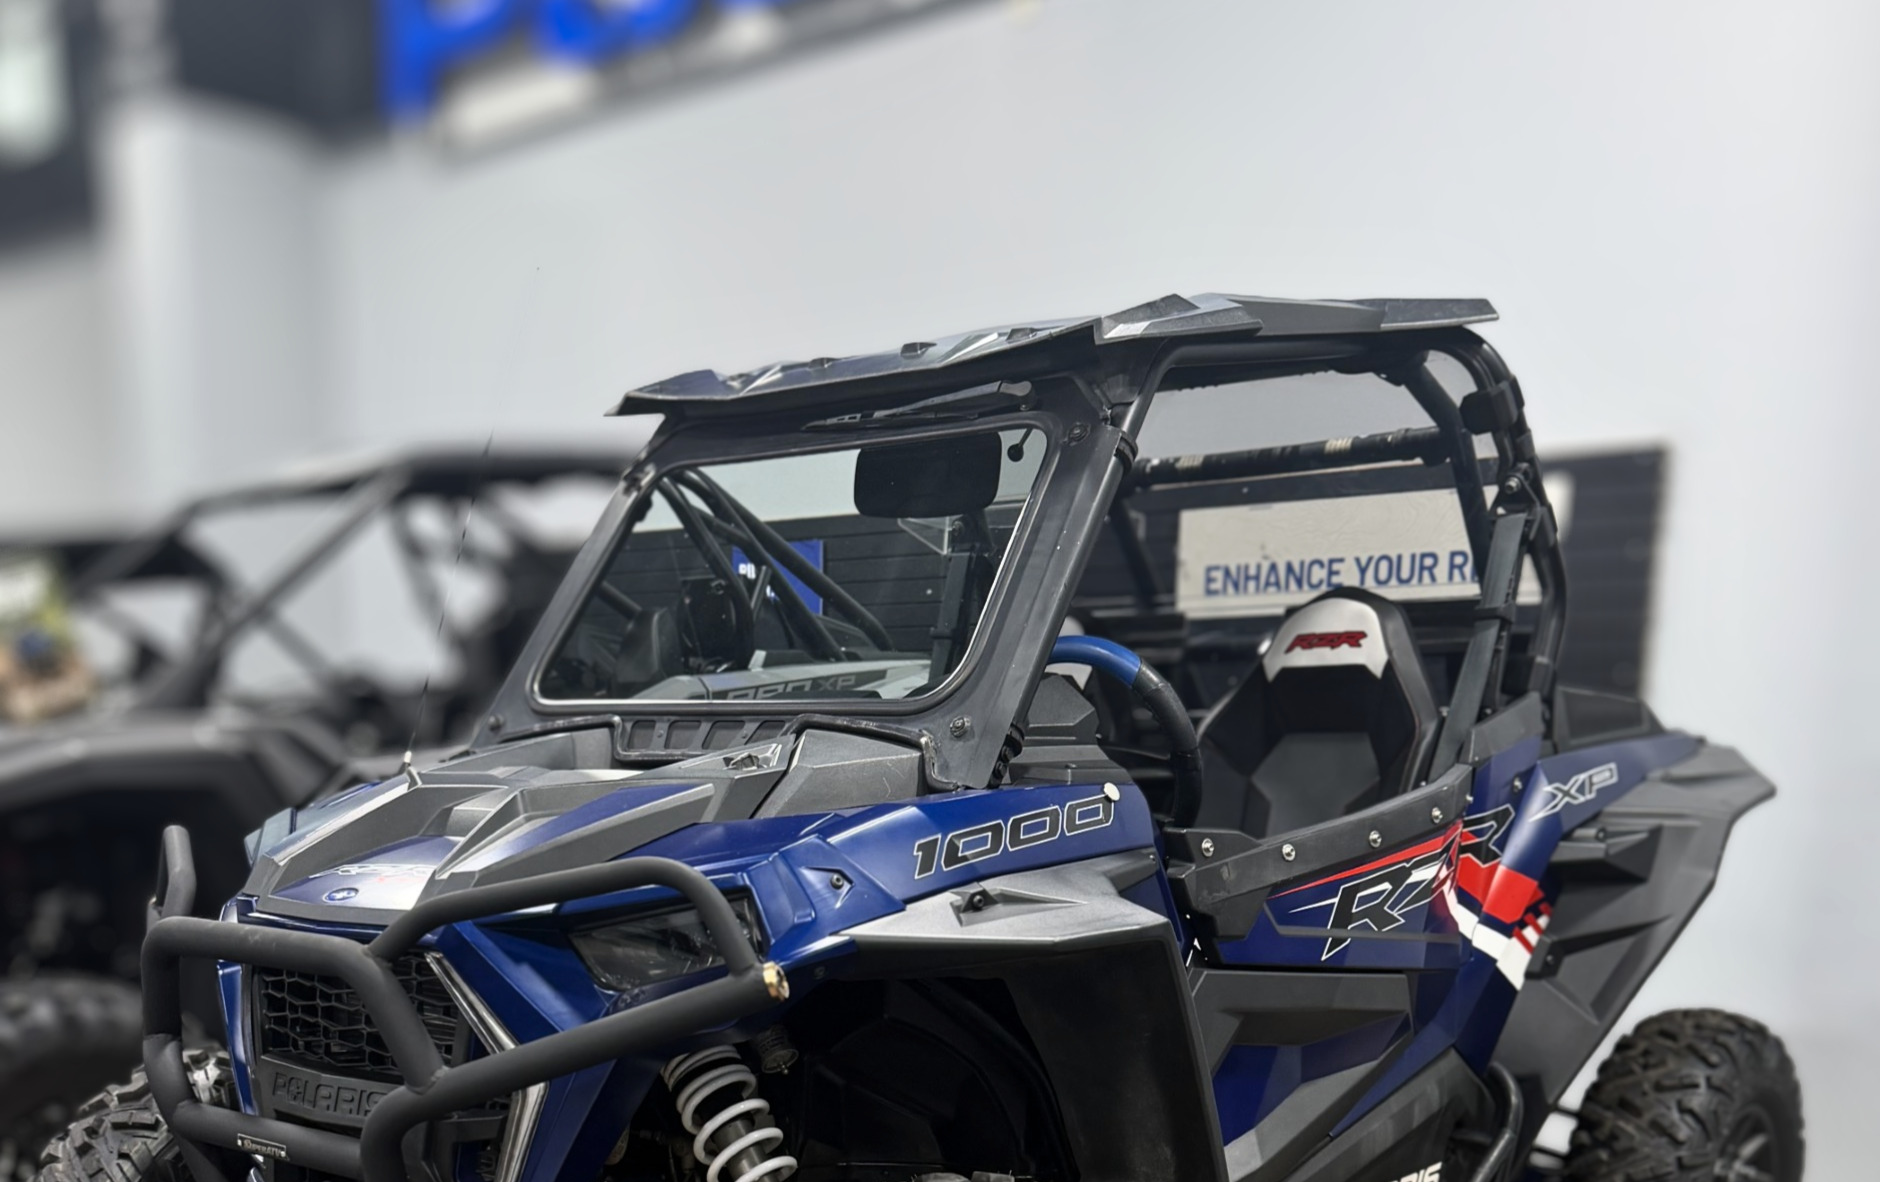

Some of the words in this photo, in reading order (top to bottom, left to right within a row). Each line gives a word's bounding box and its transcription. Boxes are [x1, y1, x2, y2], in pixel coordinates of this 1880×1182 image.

[1204, 557, 1345, 596] ENHANCE
[1354, 551, 1438, 588] YOUR
[1284, 630, 1368, 655] RZR
[1529, 762, 1619, 823] XP
[913, 793, 1115, 880] 1000
